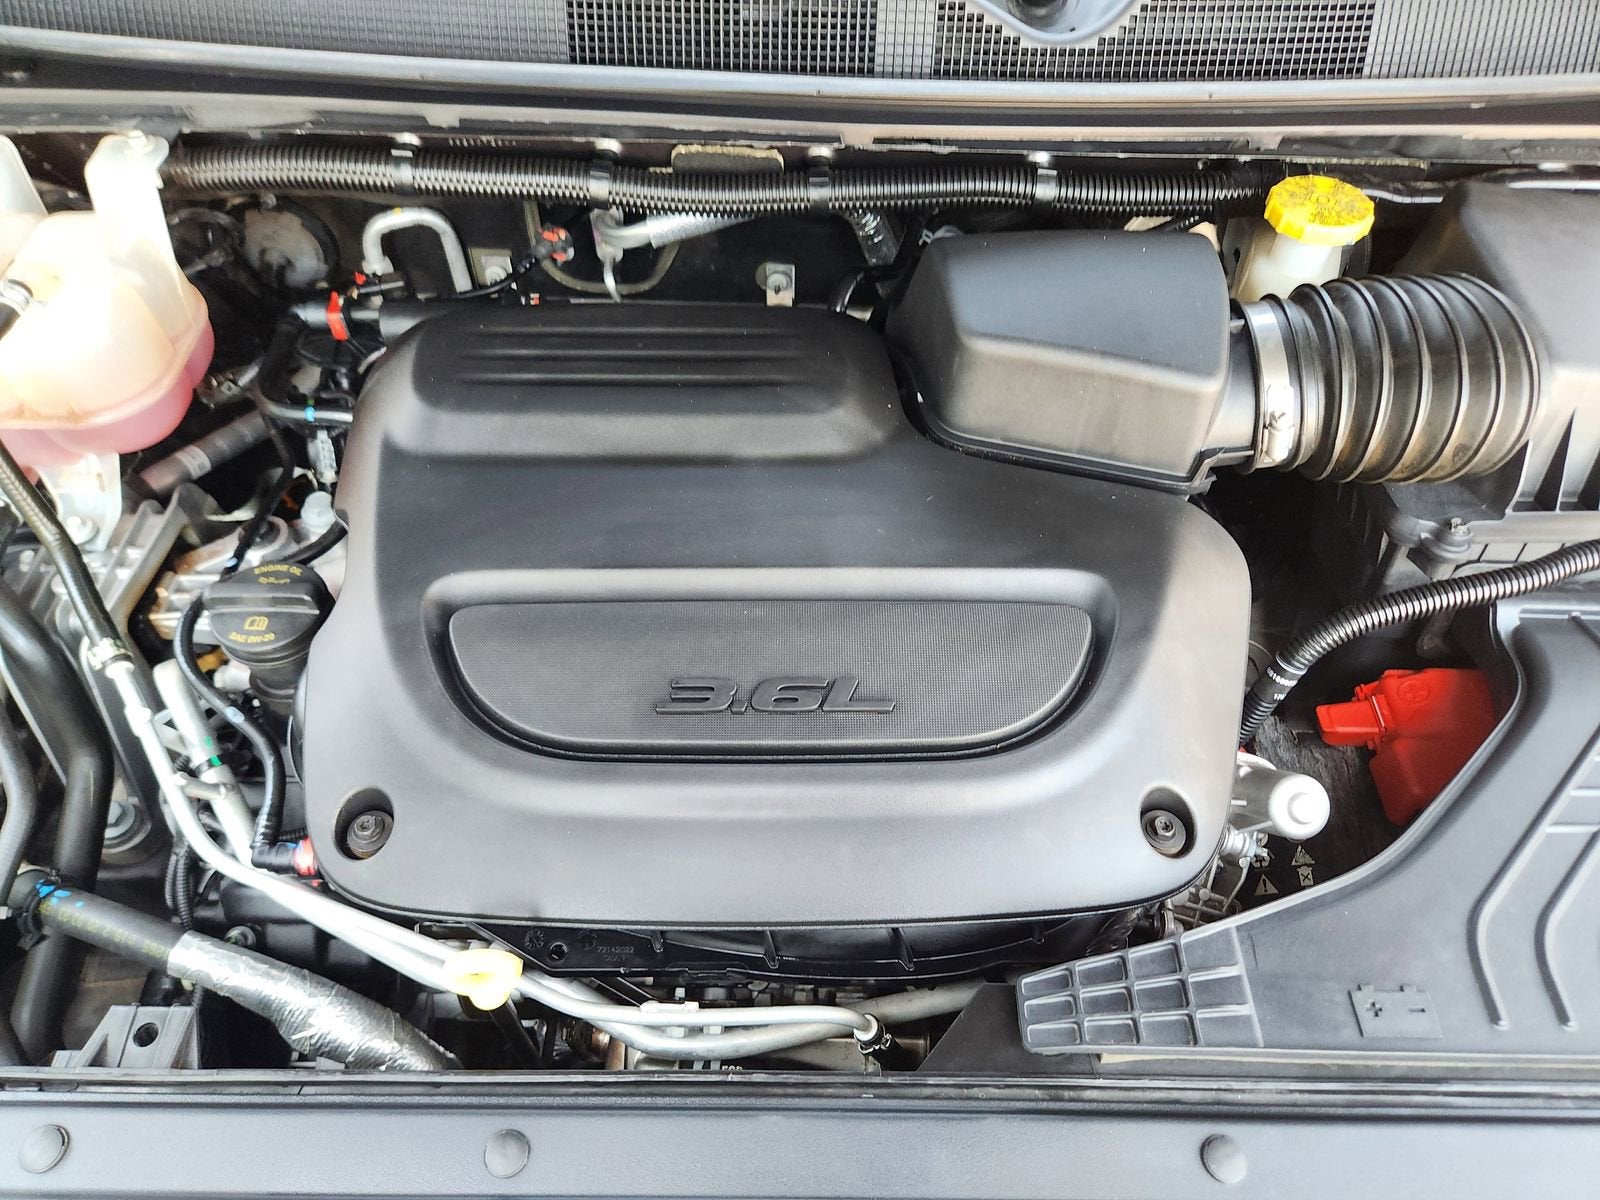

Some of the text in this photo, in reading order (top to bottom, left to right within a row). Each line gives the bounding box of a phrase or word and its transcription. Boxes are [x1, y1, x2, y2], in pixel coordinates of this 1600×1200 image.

[254, 564, 303, 577] ENGINE OIL
[229, 631, 248, 643] SAE
[654, 676, 896, 715] 3.6L
